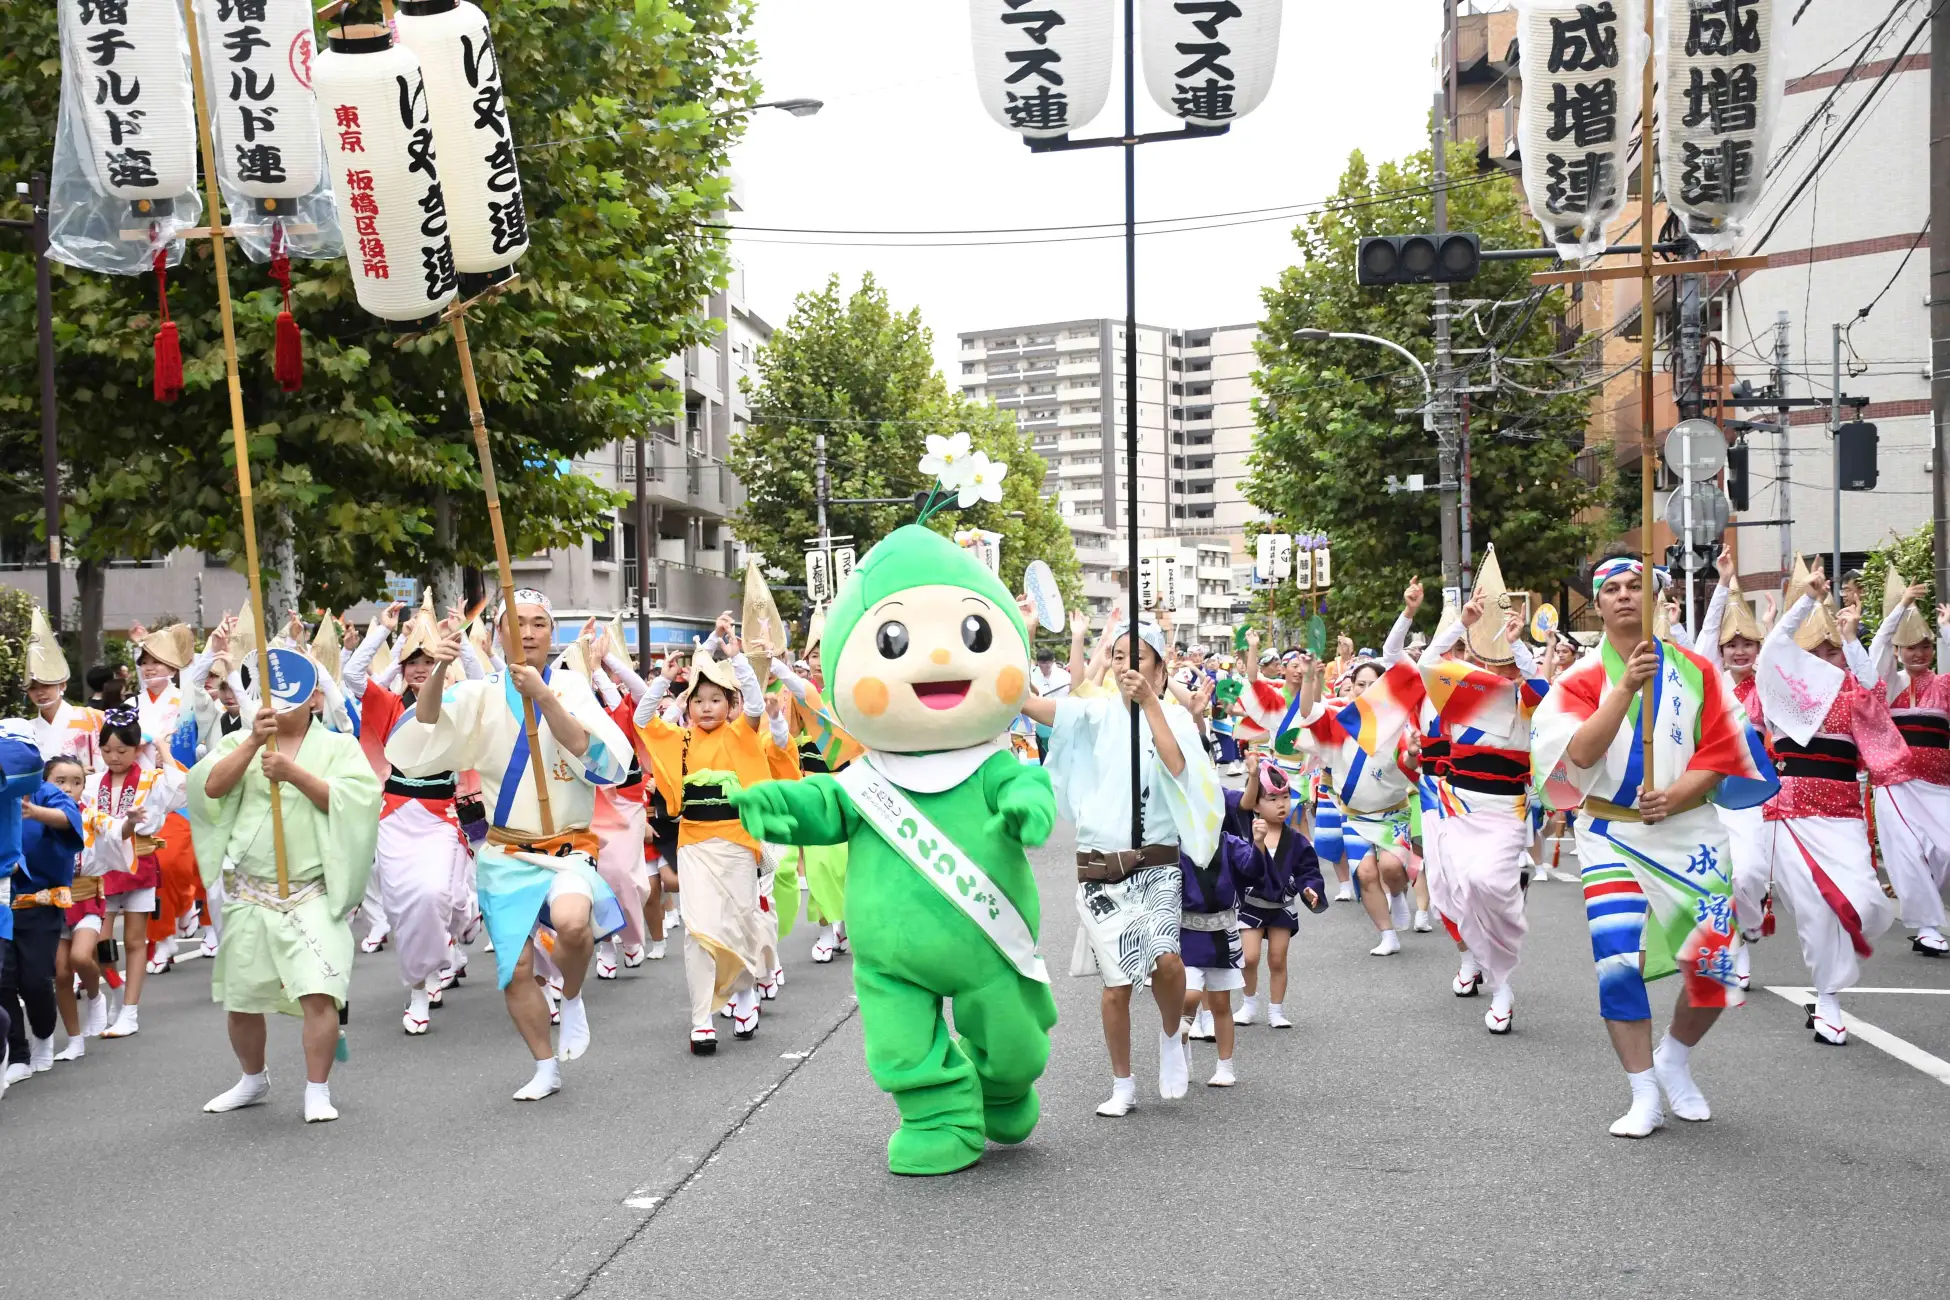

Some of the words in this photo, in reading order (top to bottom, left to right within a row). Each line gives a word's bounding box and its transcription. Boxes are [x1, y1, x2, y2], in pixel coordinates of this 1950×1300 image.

[1001, 0, 1071, 130] マス連
[1546, 2, 1619, 214] 成増連
[1681, 0, 1762, 205] 成増連
[333, 104, 366, 153] 東京
[346, 168, 390, 280] 板橋区役所
[842, 551, 852, 580] コスモ
[897, 817, 1000, 920] りんりんちゃん
[1686, 843, 1738, 987] 成増連
